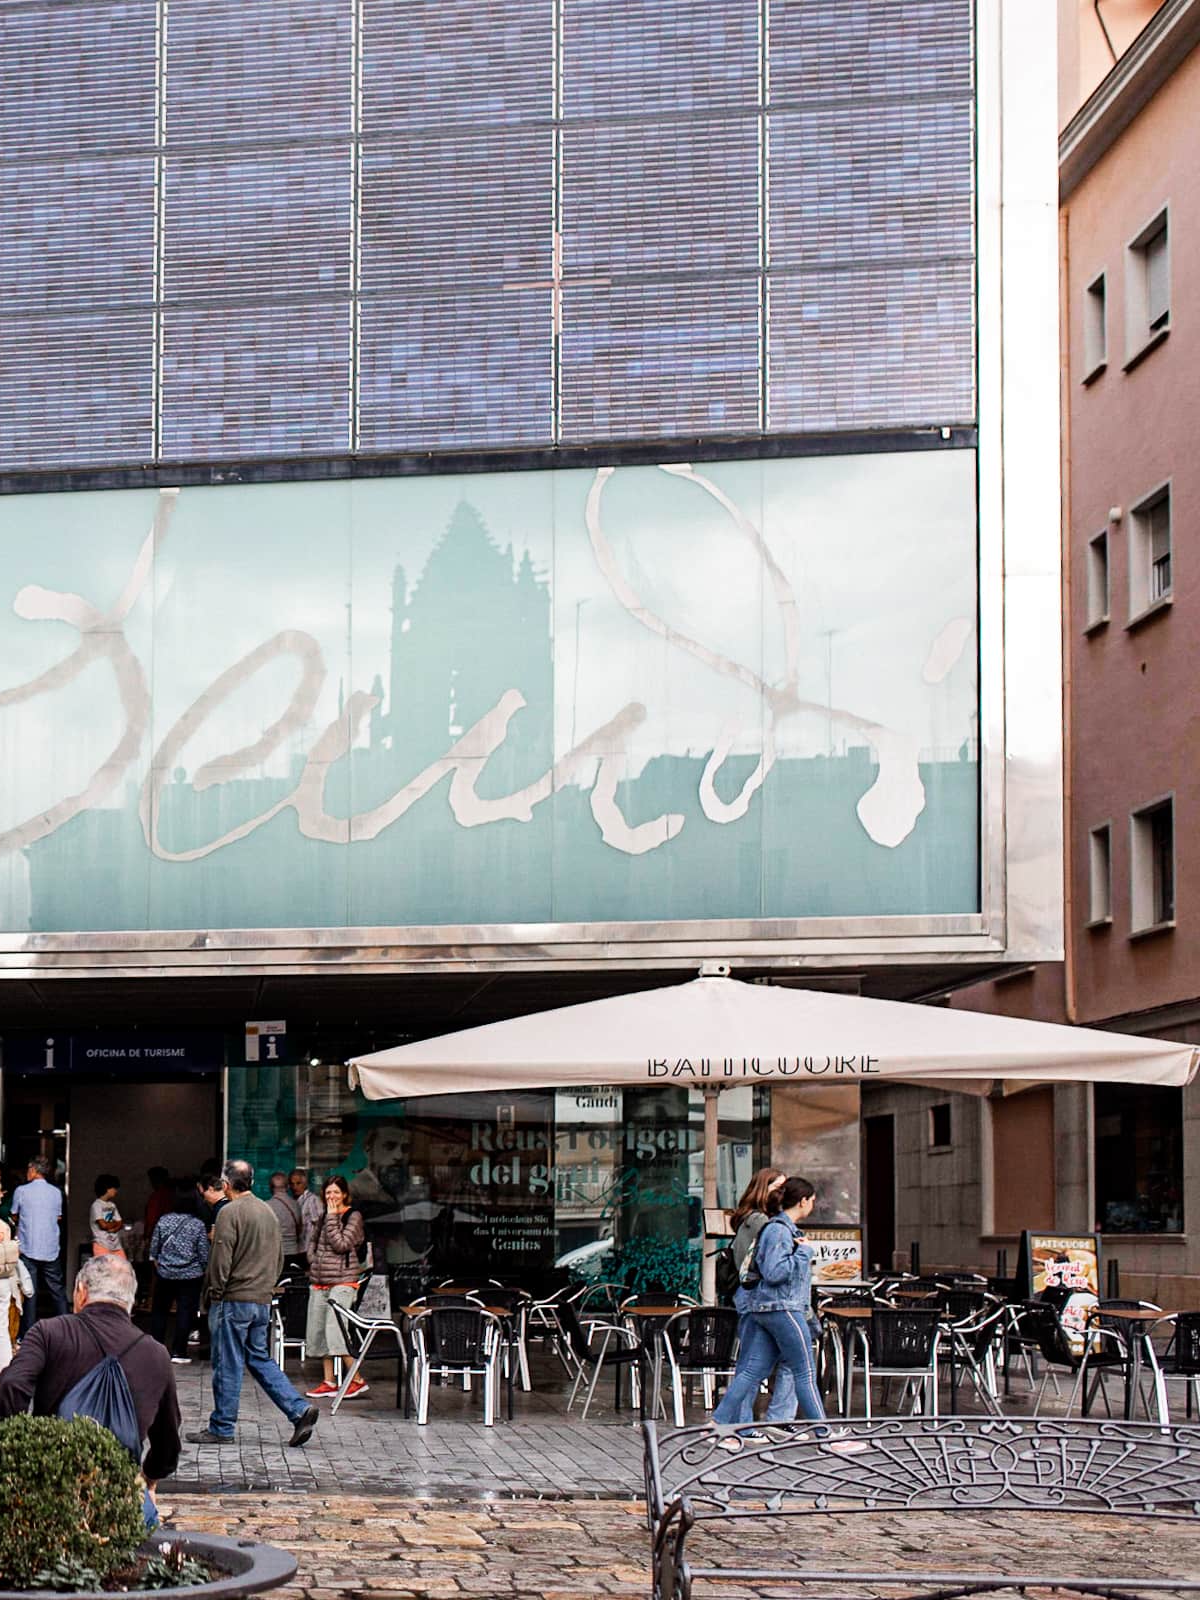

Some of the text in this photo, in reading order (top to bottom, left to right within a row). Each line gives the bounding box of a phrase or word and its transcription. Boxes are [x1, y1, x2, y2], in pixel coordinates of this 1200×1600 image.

[86, 1048, 126, 1058] OFICINA
[128, 1048, 141, 1058] DE
[144, 1048, 186, 1057] TURISME
[805, 1231, 857, 1240] ATTICUORE
